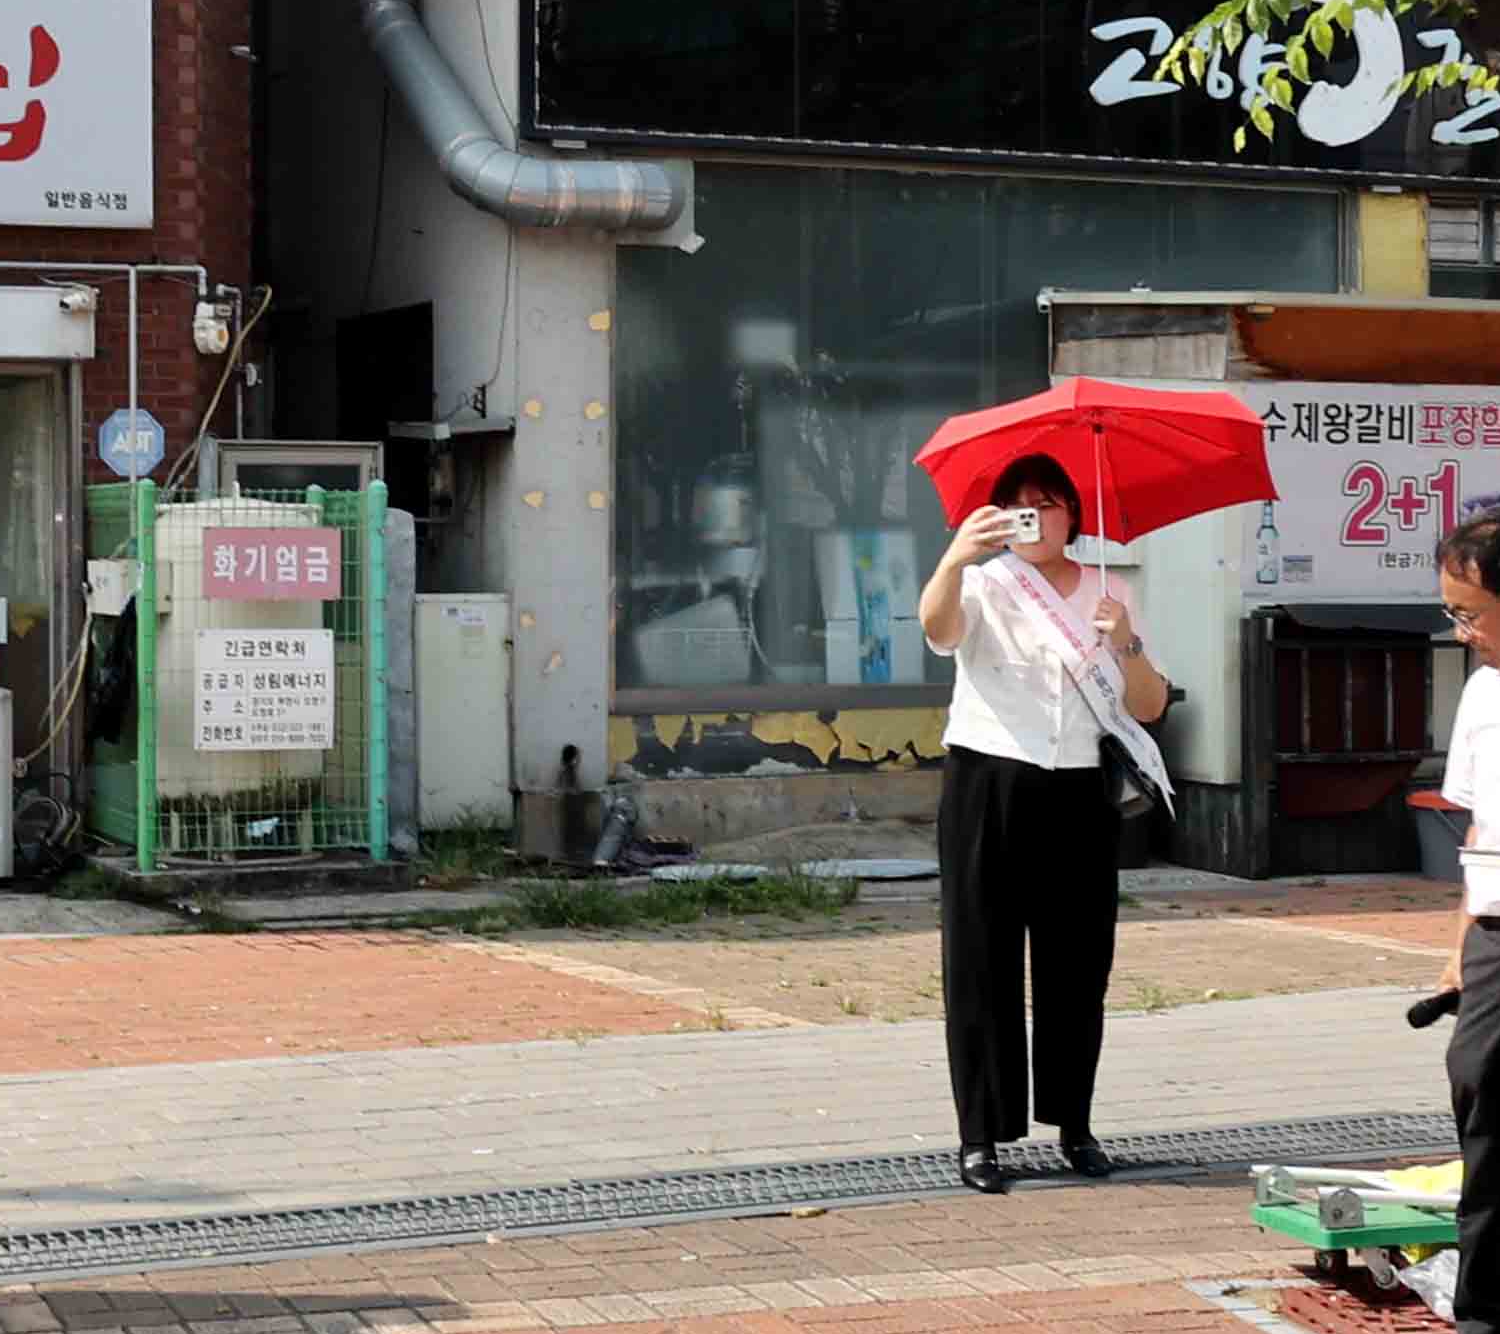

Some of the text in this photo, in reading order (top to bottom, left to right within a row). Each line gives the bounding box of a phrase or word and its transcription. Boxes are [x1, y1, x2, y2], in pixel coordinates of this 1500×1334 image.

[43, 189, 129, 212] 일반음식점
[1260, 400, 1415, 445] 수제왕갈비
[1340, 458, 1462, 547] 2+1
[212, 544, 331, 584] 화기엄금
[224, 639, 307, 658] 긴급연락처
